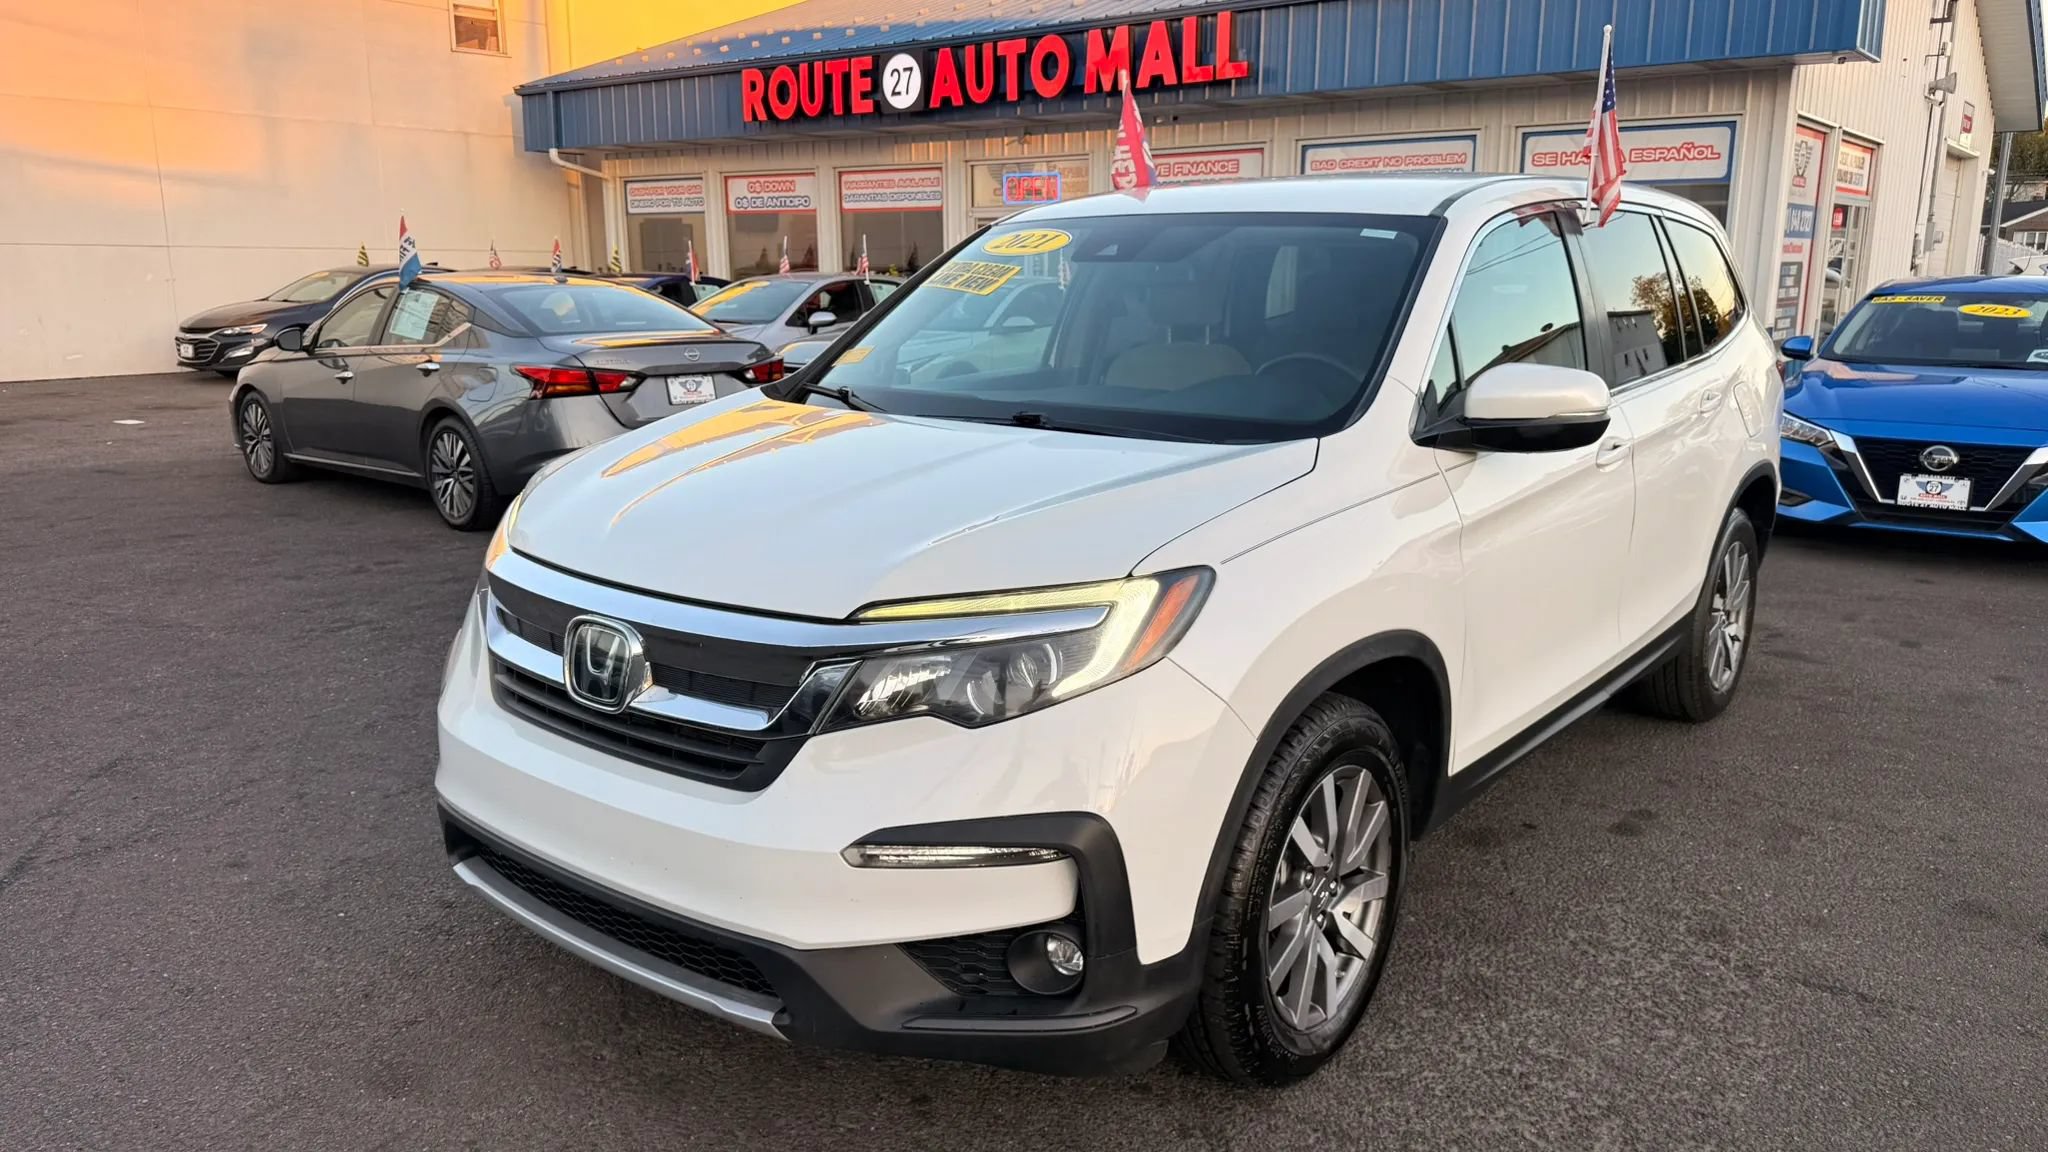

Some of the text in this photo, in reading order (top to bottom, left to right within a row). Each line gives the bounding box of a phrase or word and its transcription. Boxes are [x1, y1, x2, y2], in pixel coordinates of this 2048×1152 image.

[741, 10, 1249, 122] ROUTE 27 AUTO MALL
[1532, 152, 1556, 166] SE
[1629, 142, 1720, 163] ESPAÑOL
[1173, 160, 1240, 176] FINANCE
[1311, 153, 1467, 171] BAD CREDIT NO PROBLEM
[763, 180, 796, 192] DOWN
[1005, 176, 1059, 202] OPEN
[751, 196, 765, 208] DE
[766, 195, 811, 208] ANTICIPO
[990, 233, 1063, 249] 2021
[1976, 305, 2022, 316] 2023
